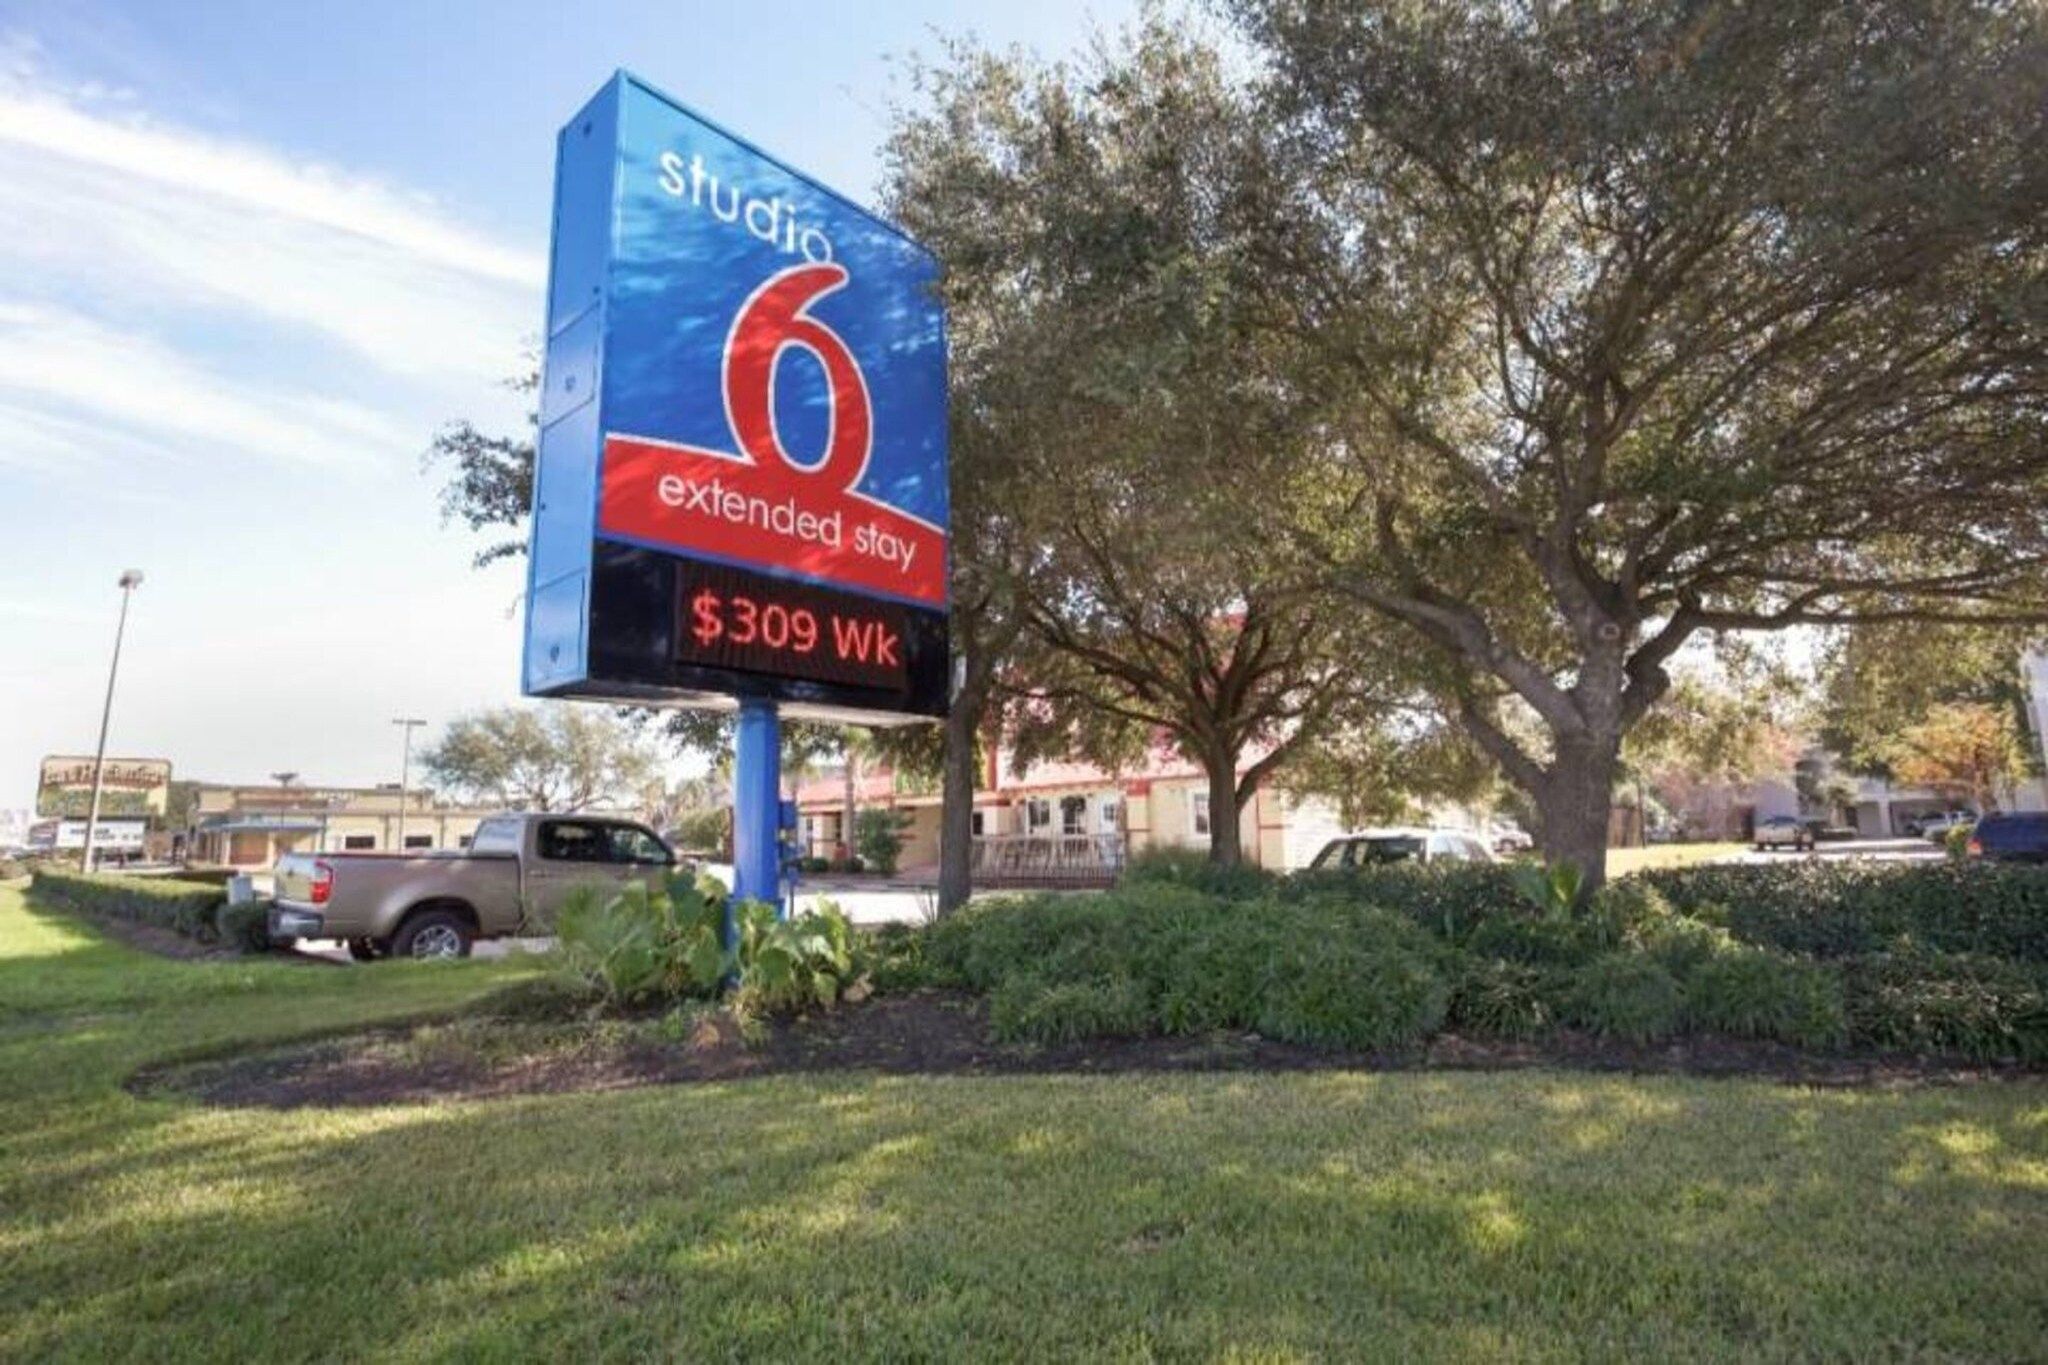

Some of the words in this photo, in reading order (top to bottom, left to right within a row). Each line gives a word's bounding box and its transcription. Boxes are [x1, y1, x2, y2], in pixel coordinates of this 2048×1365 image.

[658, 150, 833, 262] studio
[721, 262, 874, 486] 6
[658, 474, 841, 548] extended
[854, 524, 917, 573] stay
[692, 588, 817, 652] $309
[831, 617, 899, 667] Wk
